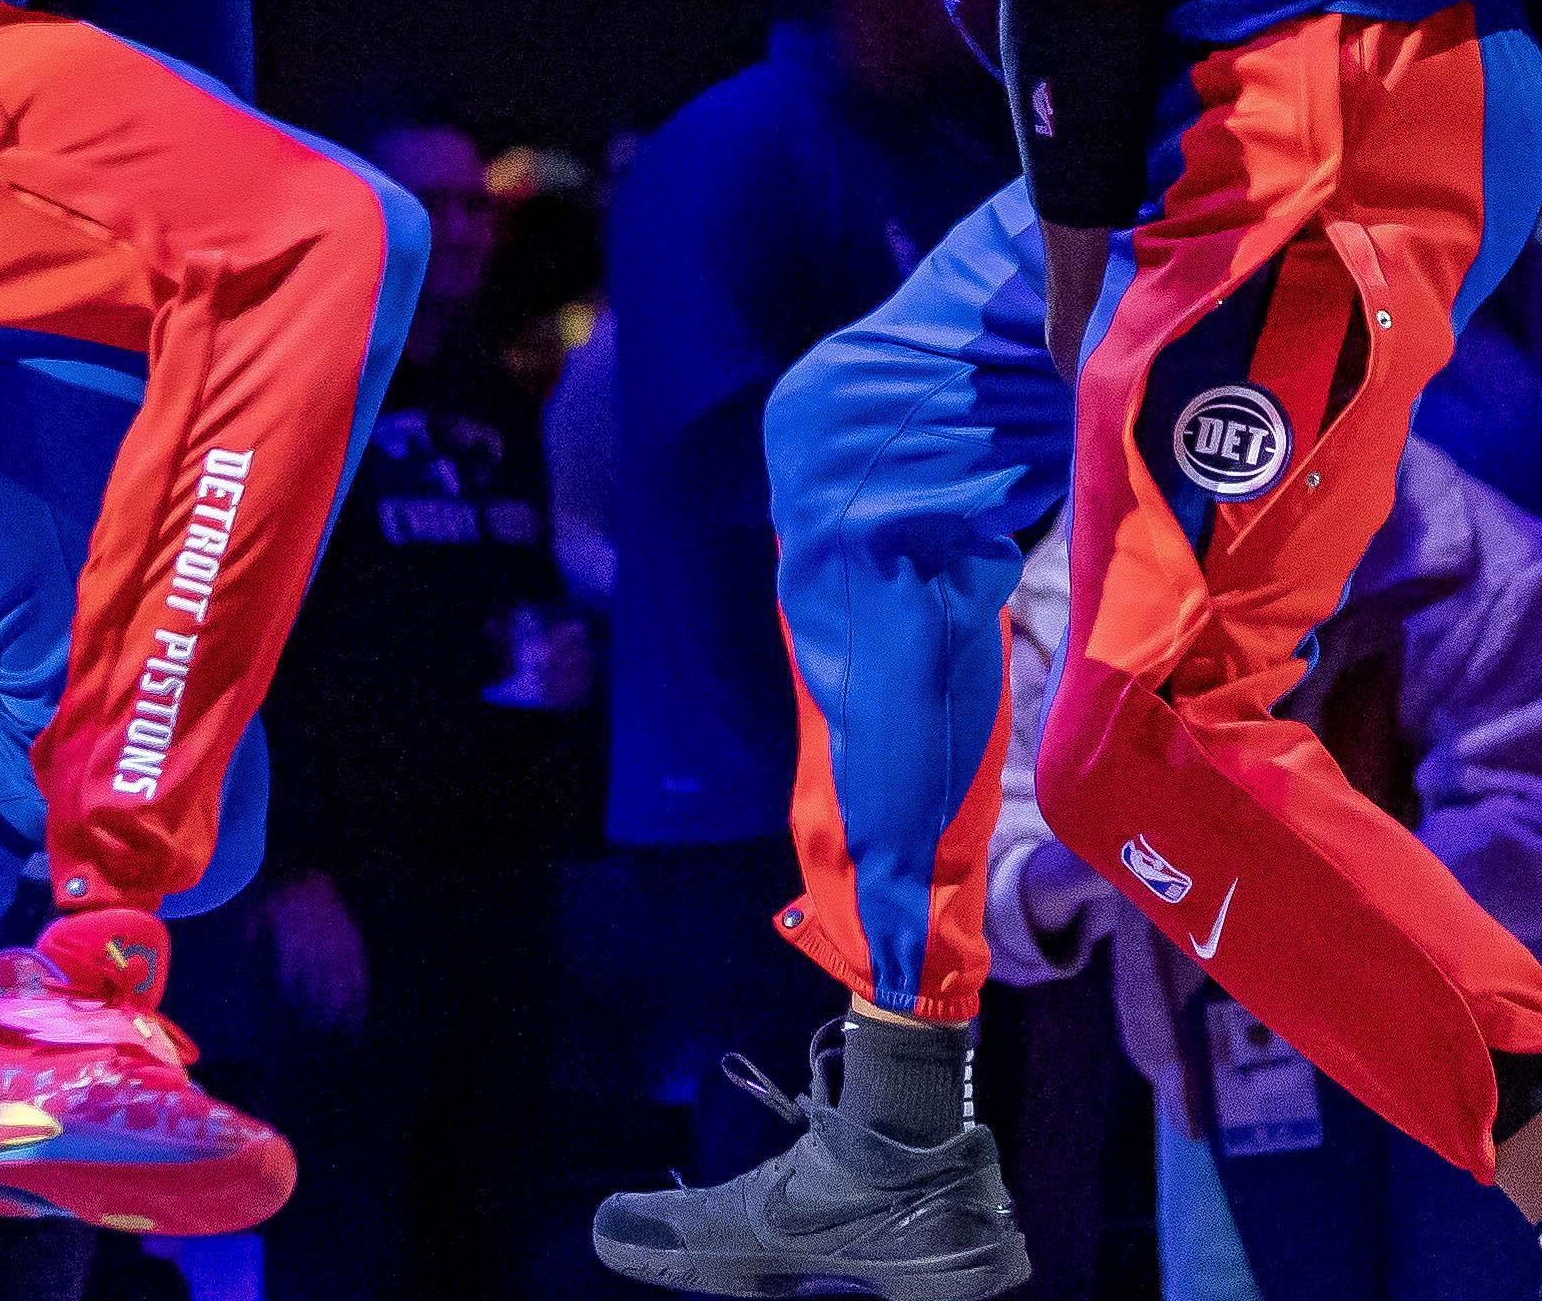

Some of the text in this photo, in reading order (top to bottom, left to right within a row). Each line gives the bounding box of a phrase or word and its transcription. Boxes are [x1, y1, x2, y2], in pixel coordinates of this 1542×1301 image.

[1195, 416, 1270, 465] DET
[112, 448, 254, 801] DETROIT PISTONS
